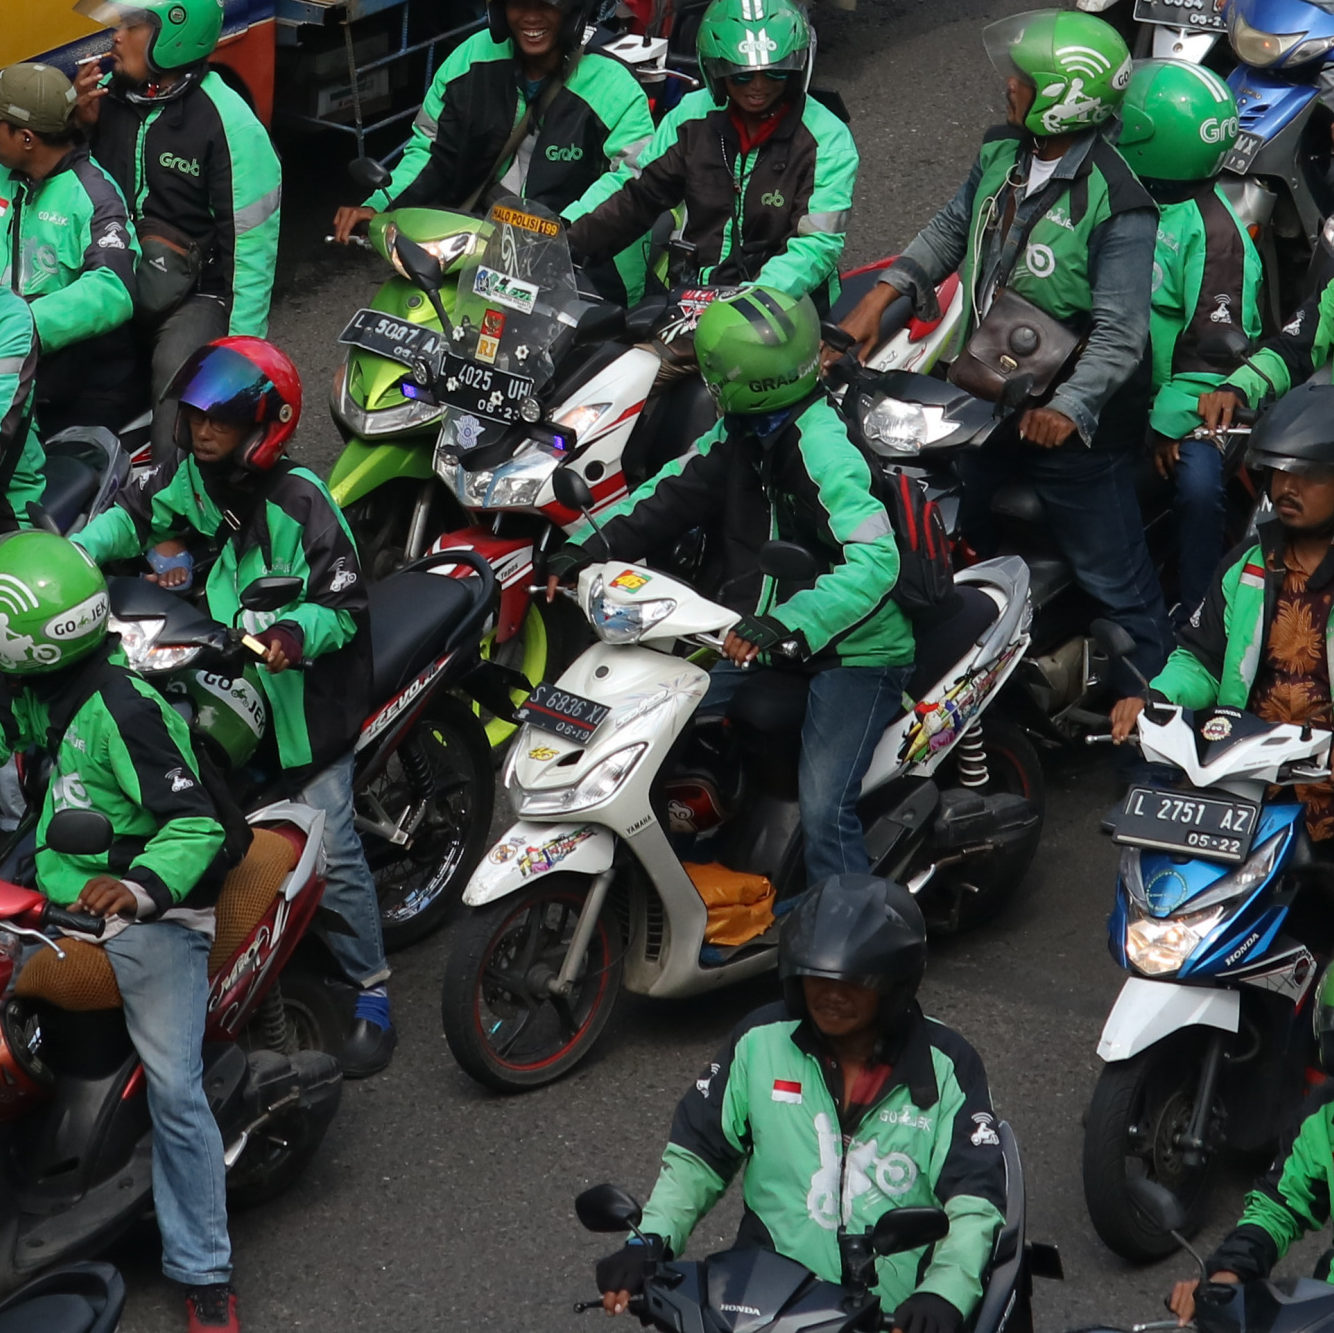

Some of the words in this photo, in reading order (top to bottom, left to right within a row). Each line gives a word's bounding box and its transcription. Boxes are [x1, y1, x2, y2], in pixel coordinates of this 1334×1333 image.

[738, 38, 777, 54] Grab
[545, 143, 583, 161] Grab
[159, 151, 200, 177] Grab
[511, 211, 537, 230] POLISI
[540, 220, 559, 236] 199
[354, 314, 364, 329] L
[478, 339, 497, 358] RI
[458, 364, 495, 392] 4025
[53, 619, 76, 637] GO
[91, 597, 107, 622] JEK
[206, 672, 234, 691] GO
[530, 686, 546, 704] S
[547, 691, 587, 718] 6836
[626, 814, 652, 835] YAMAHA
[1134, 796, 1144, 817] L
[1157, 799, 1206, 826] 2751
[1219, 809, 1249, 832] AZ
[1225, 932, 1260, 967] HONDA
[719, 1303, 762, 1317] HONDA
